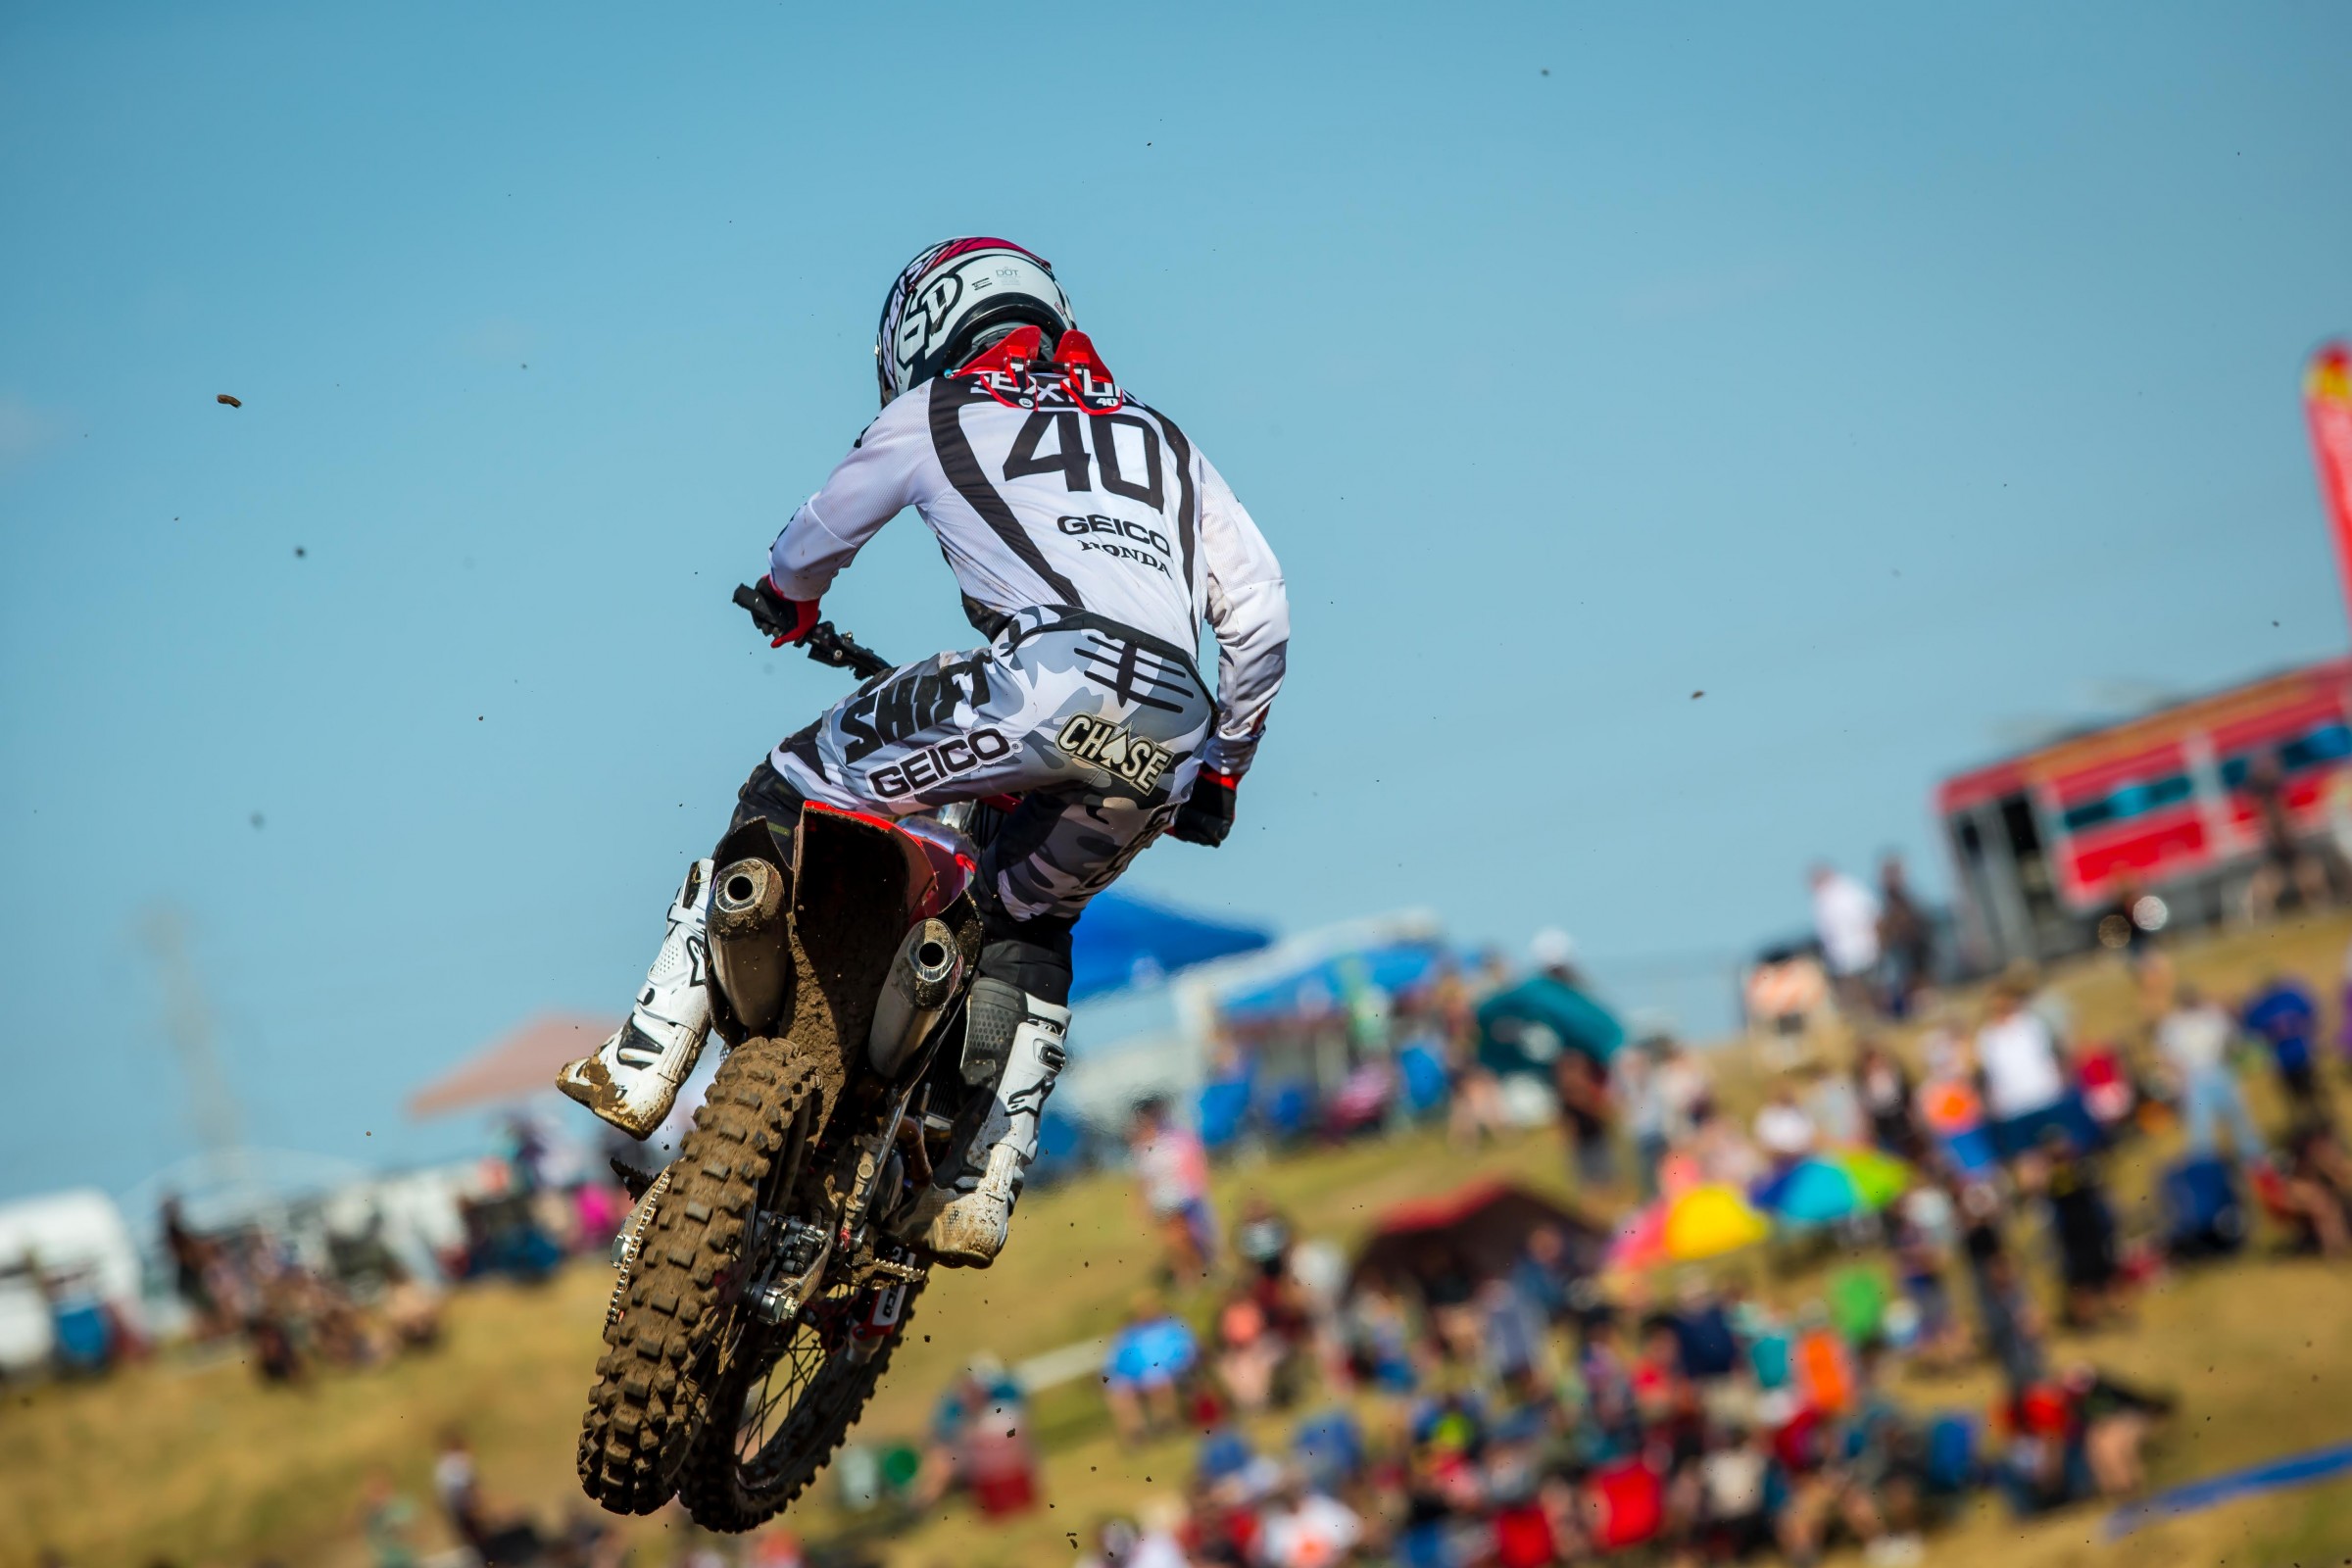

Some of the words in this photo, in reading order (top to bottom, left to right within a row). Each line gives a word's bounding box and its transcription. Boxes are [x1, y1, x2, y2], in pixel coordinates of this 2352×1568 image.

[1096, 397, 1119, 407] 40
[1003, 411, 1165, 515] 40
[1056, 514, 1172, 559] GEICO
[840, 652, 994, 765] SHIFT
[869, 728, 1010, 798] GEICO
